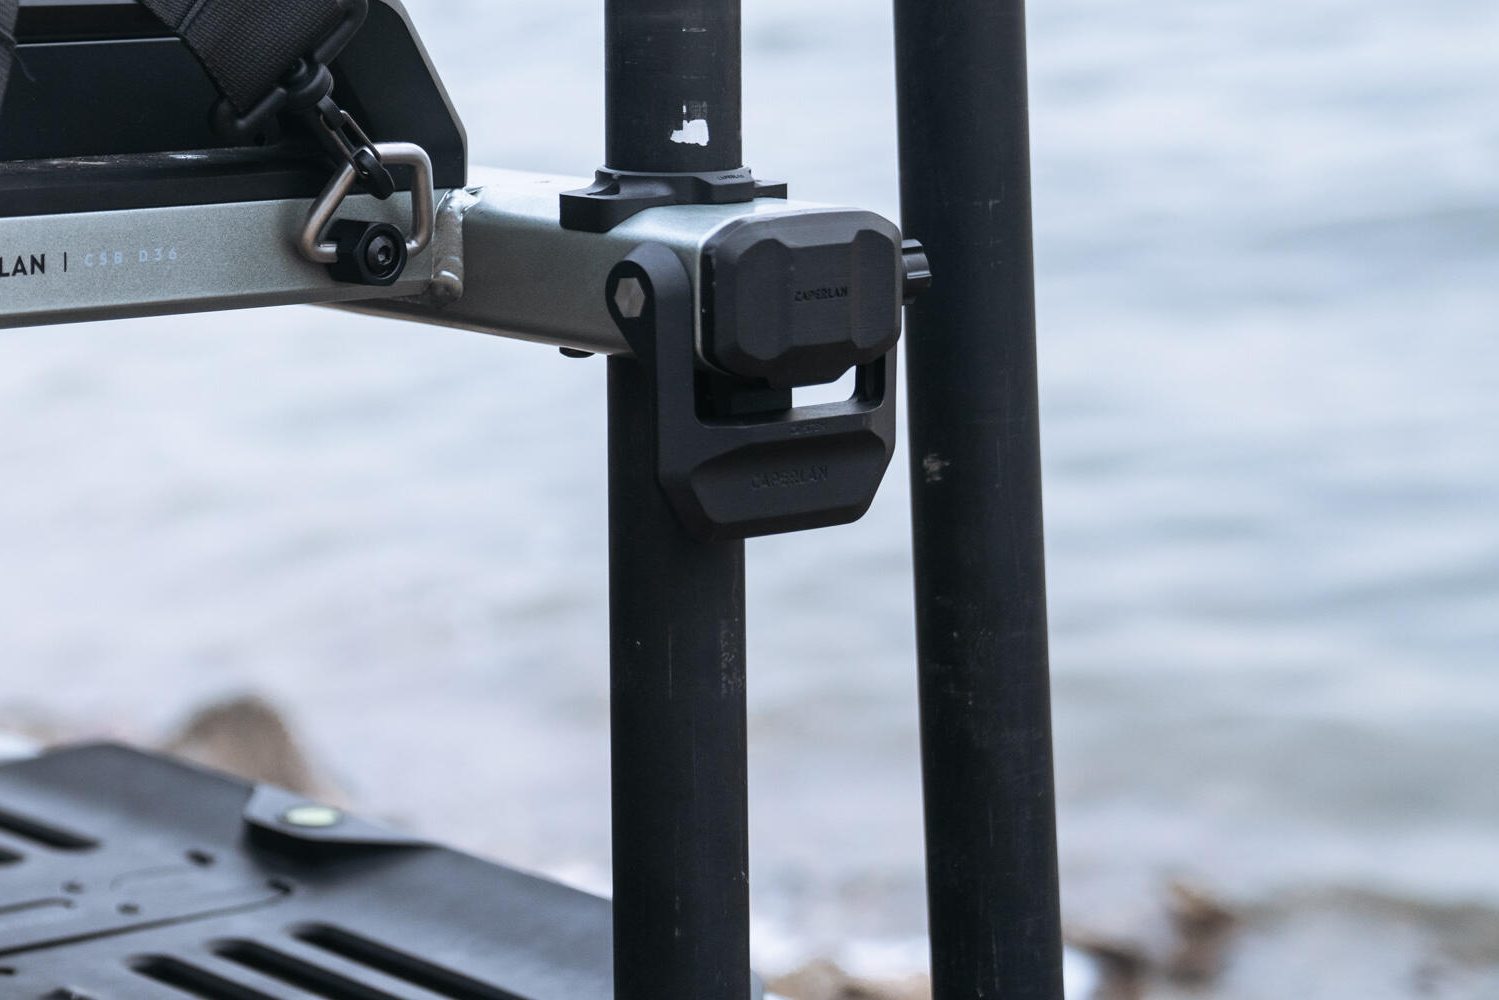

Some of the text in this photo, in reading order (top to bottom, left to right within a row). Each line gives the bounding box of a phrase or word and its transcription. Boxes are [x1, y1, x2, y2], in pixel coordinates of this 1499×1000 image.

[84, 251, 123, 267] CSB
[138, 248, 177, 262] D36
[794, 286, 848, 302] CAPERLAN
[751, 464, 828, 489] CAPERLAN
